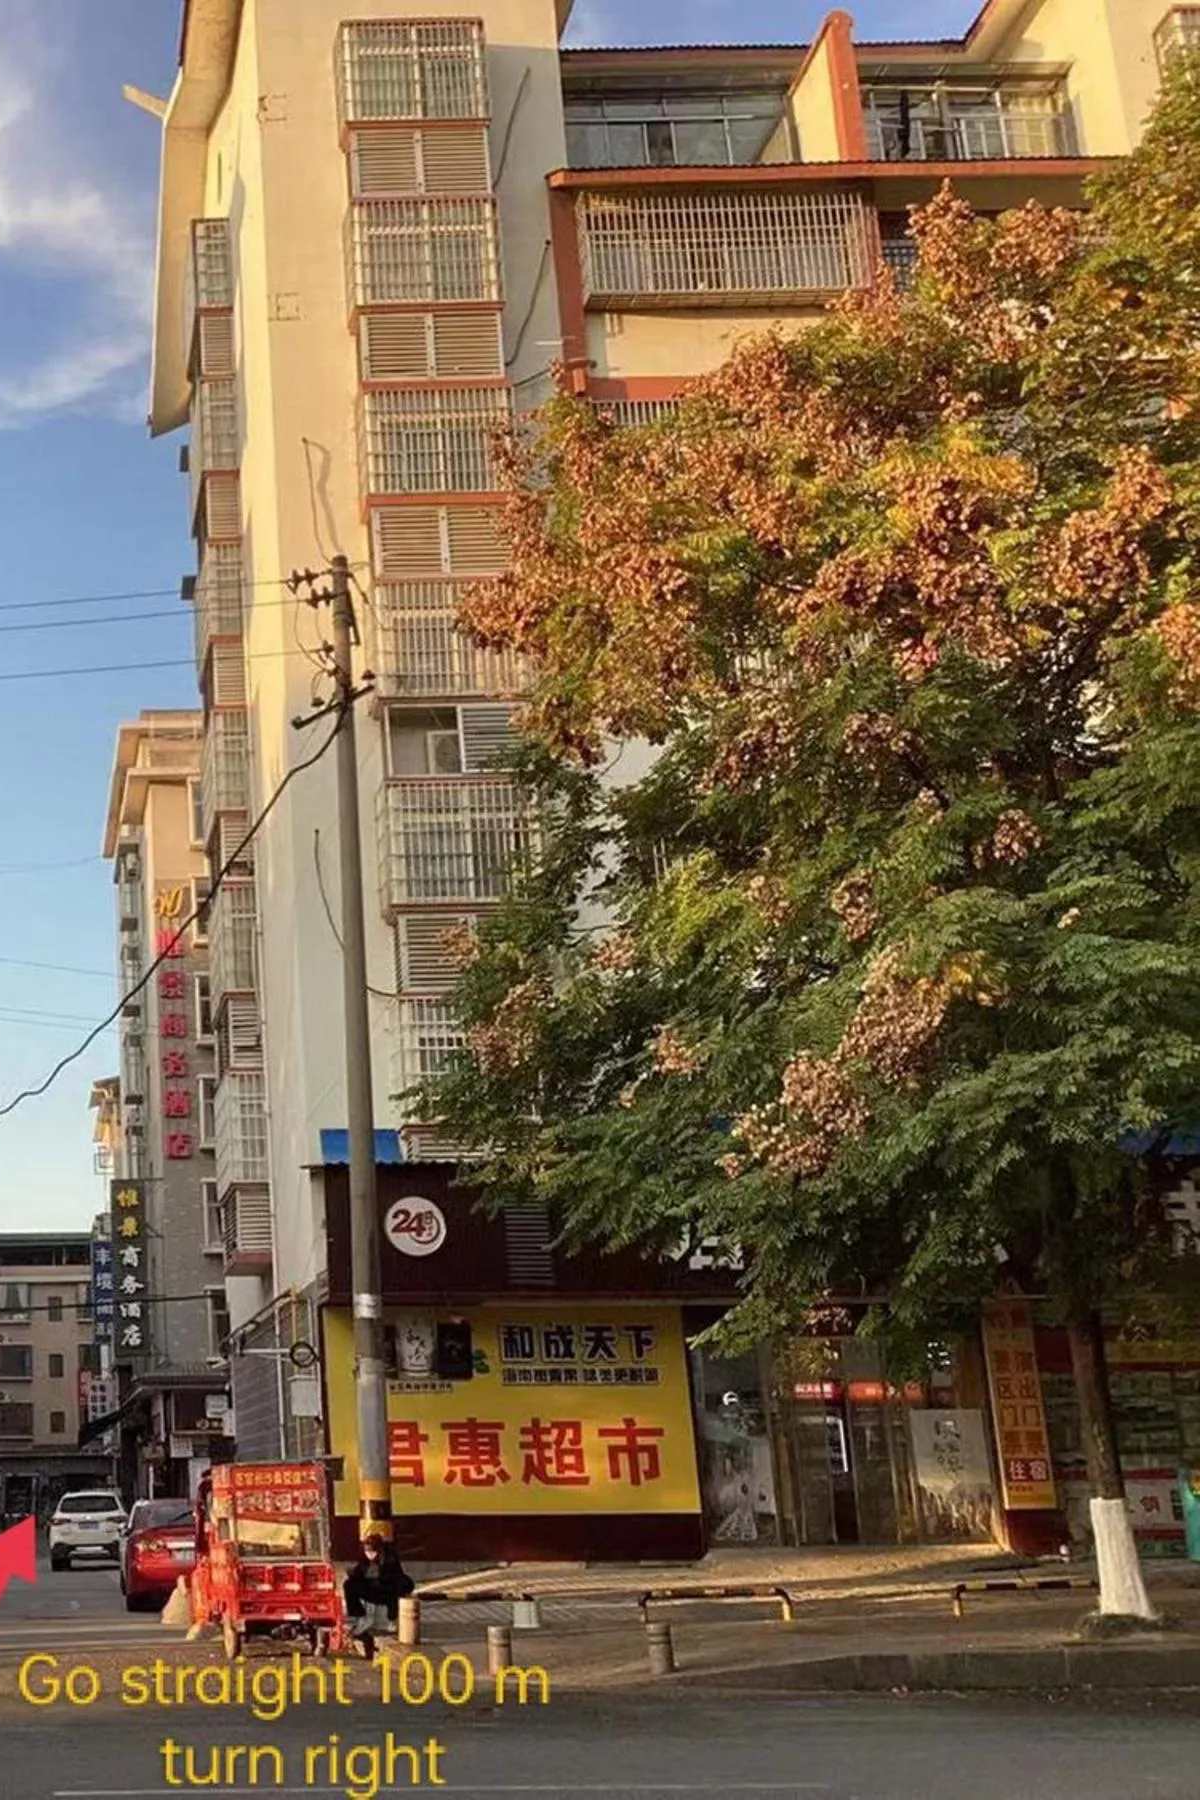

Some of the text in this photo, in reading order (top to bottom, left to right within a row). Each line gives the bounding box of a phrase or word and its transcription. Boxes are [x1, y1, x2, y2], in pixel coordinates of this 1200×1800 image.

[391, 1208, 427, 1237] 24
[501, 1323, 656, 1361] 和成天下
[386, 1417, 665, 1488] 君惠超市
